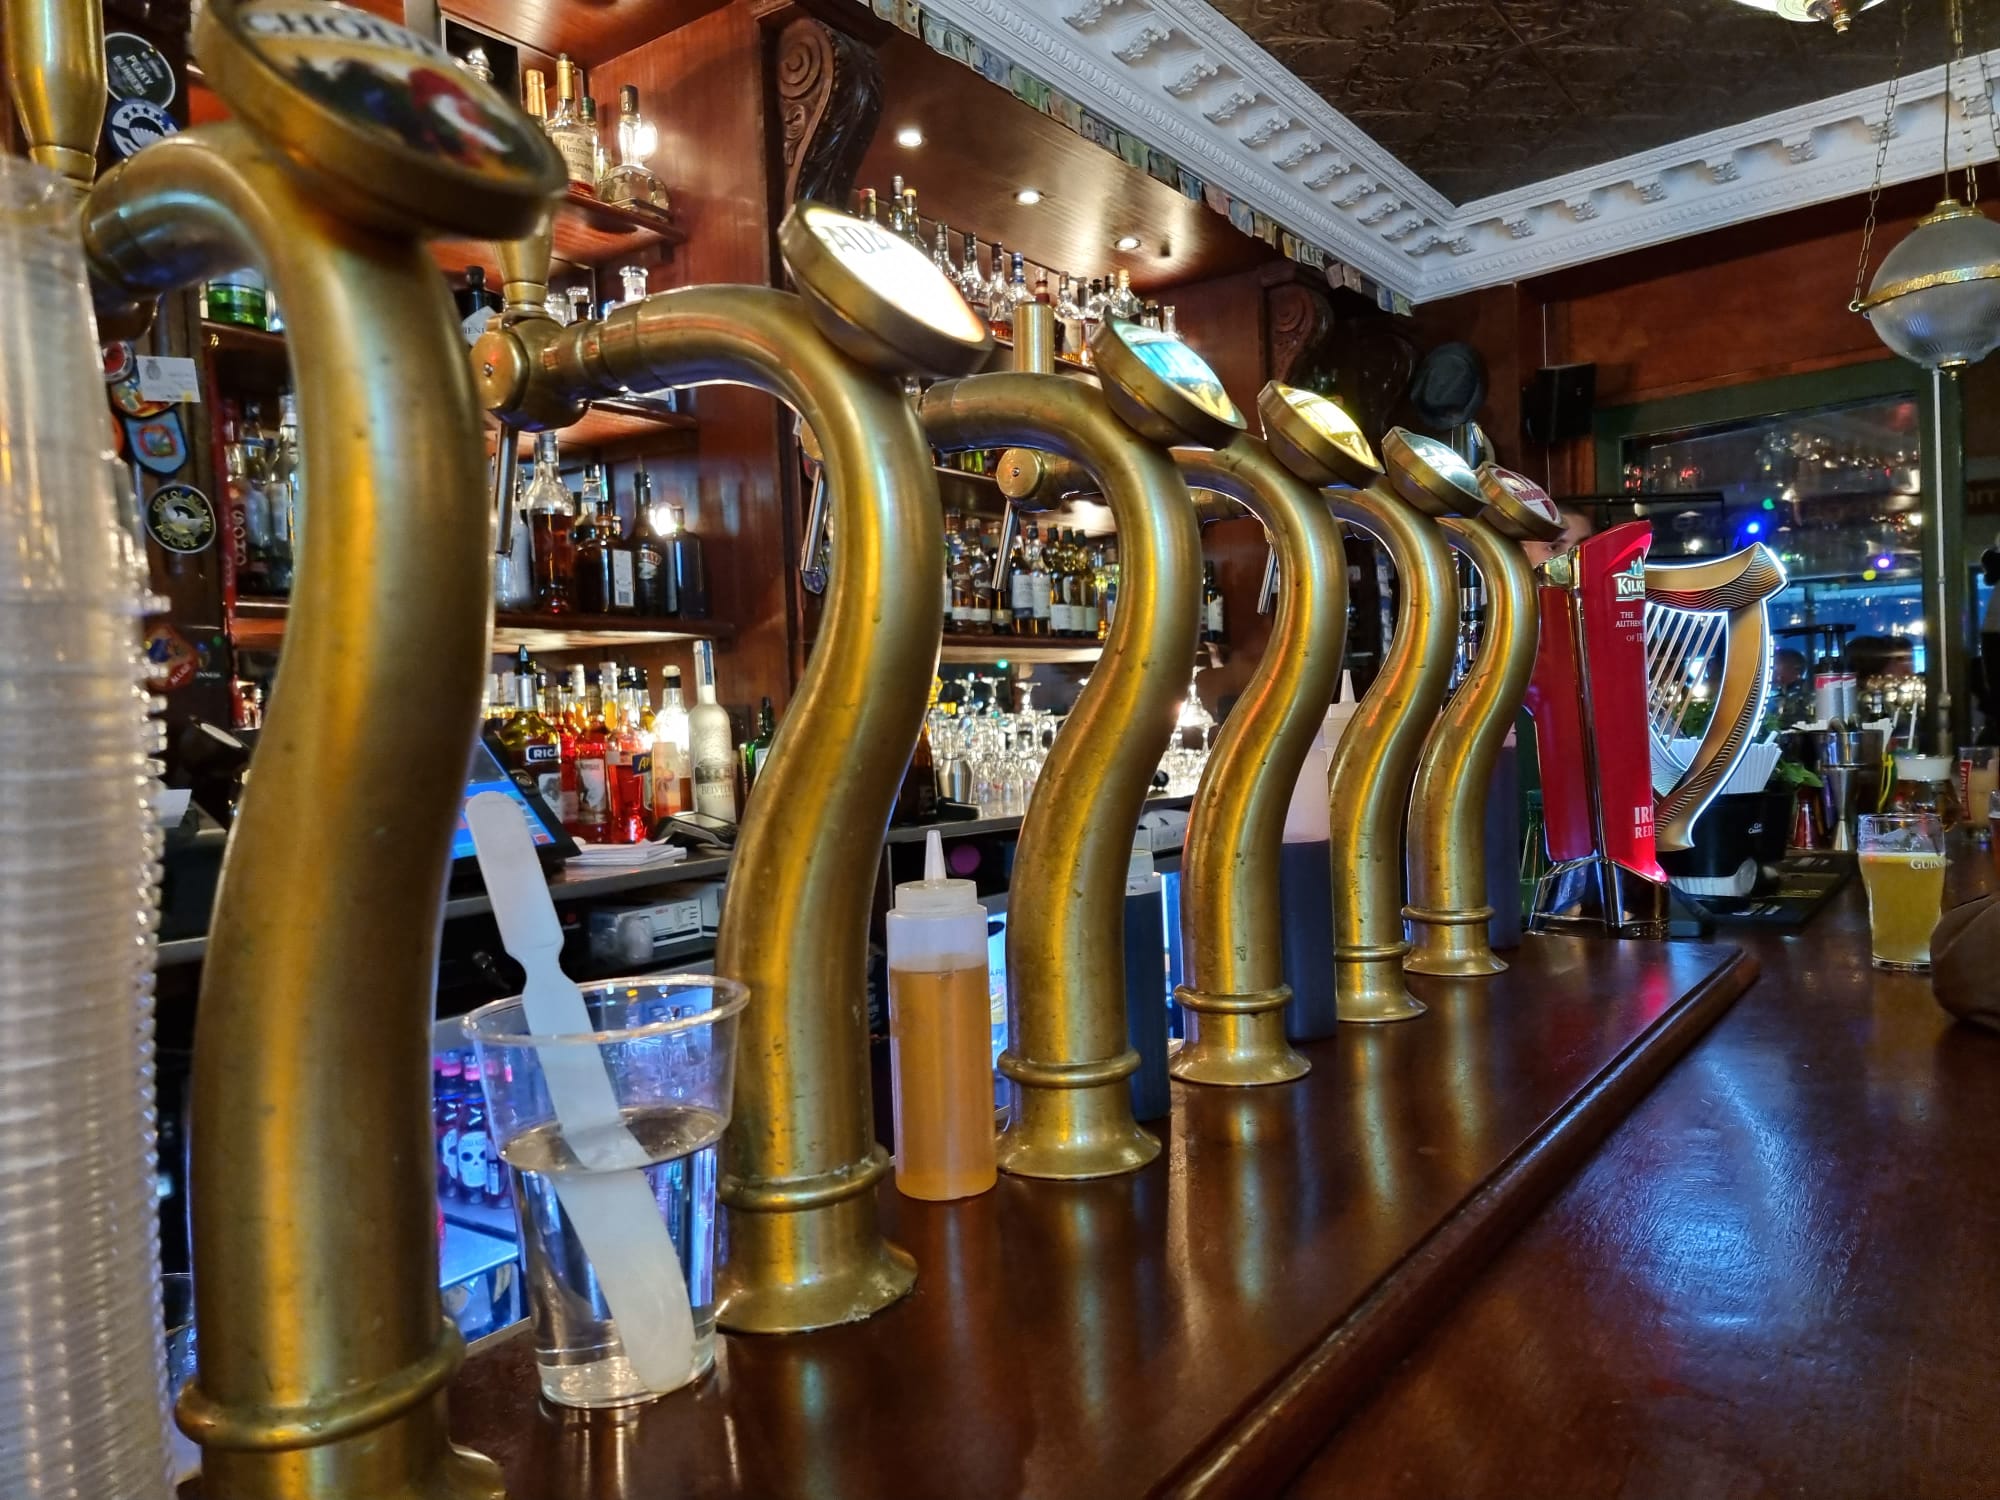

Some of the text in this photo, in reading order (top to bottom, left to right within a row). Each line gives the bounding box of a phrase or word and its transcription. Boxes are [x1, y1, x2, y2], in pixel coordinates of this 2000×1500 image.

[126, 54, 154, 84] PEAKY
[154, 524, 199, 549] POLICE
[1620, 611, 1635, 619] THE
[1634, 825, 1654, 839] RED
